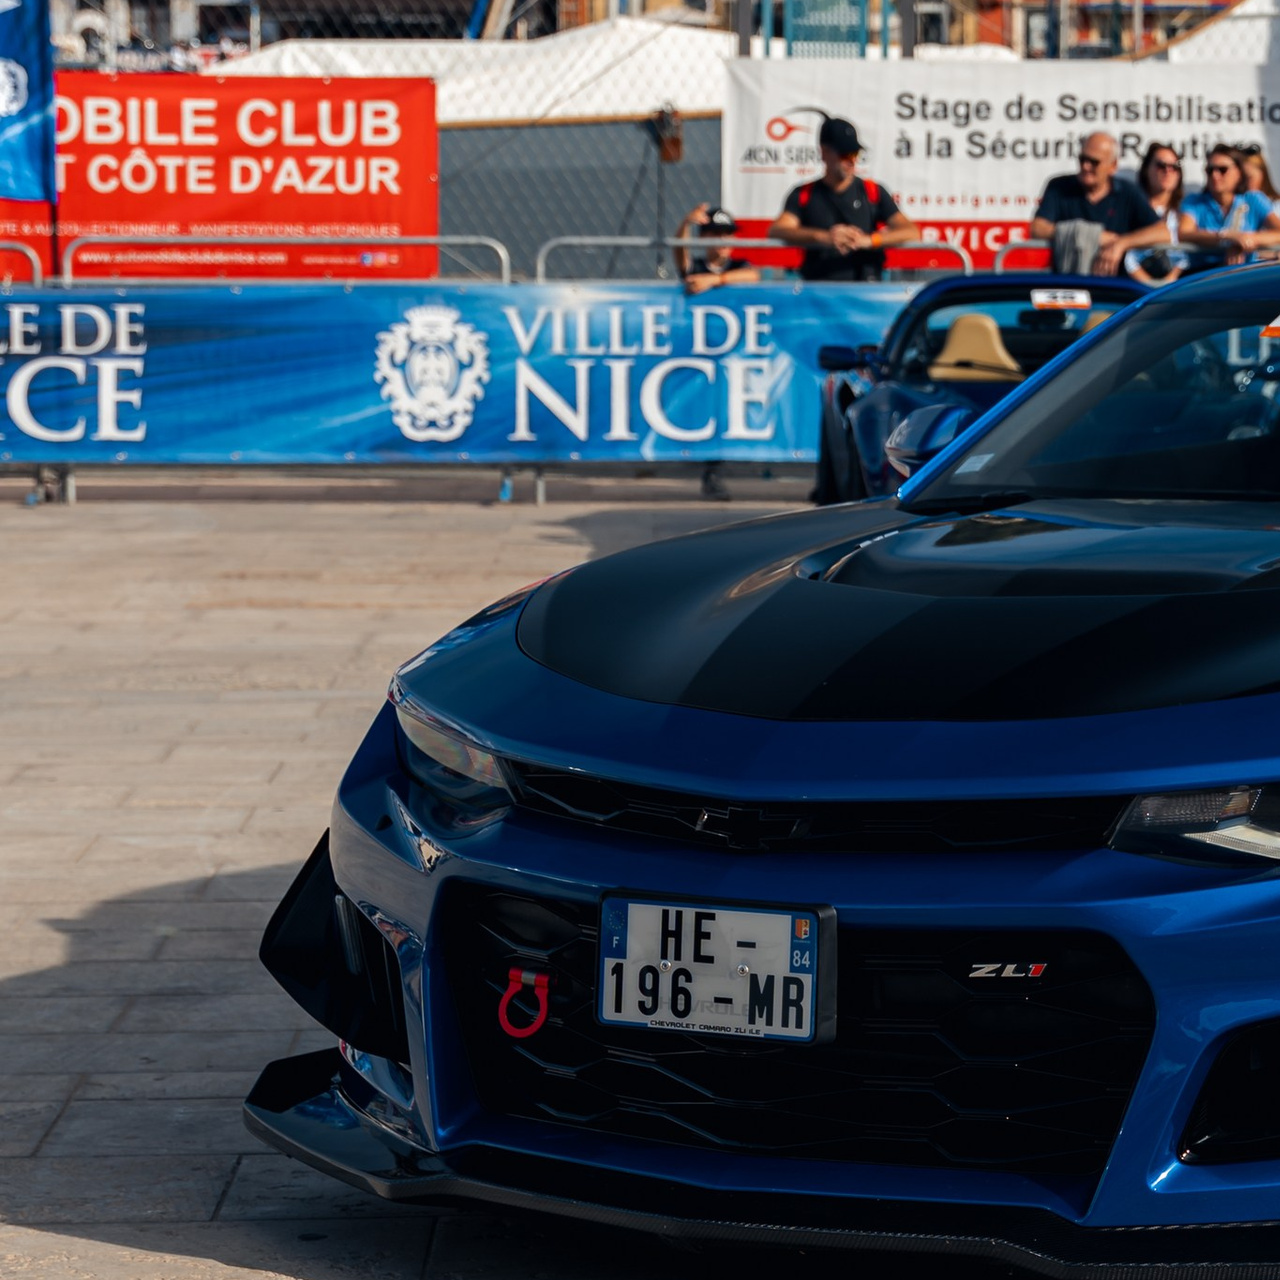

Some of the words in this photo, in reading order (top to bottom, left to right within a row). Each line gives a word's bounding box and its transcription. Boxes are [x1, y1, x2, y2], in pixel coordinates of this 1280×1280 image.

[236, 98, 401, 147] CLUB
[895, 92, 992, 127] Stage
[1005, 94, 1045, 120] de
[895, 133, 912, 159] à
[926, 131, 951, 159] la
[86, 147, 216, 194] CÔTE
[230, 156, 401, 195] D'AZUR
[57, 303, 148, 356] DE
[503, 304, 673, 356] VILLE
[691, 304, 775, 356] DE
[0, 355, 148, 442] CE
[507, 356, 776, 442] NICE
[612, 936, 620, 949] F
[793, 950, 811, 968] 84
[968, 963, 1048, 977] ZL1
[650, 1019, 697, 1030] CHEVROLET
[698, 1024, 732, 1033] CAMARO
